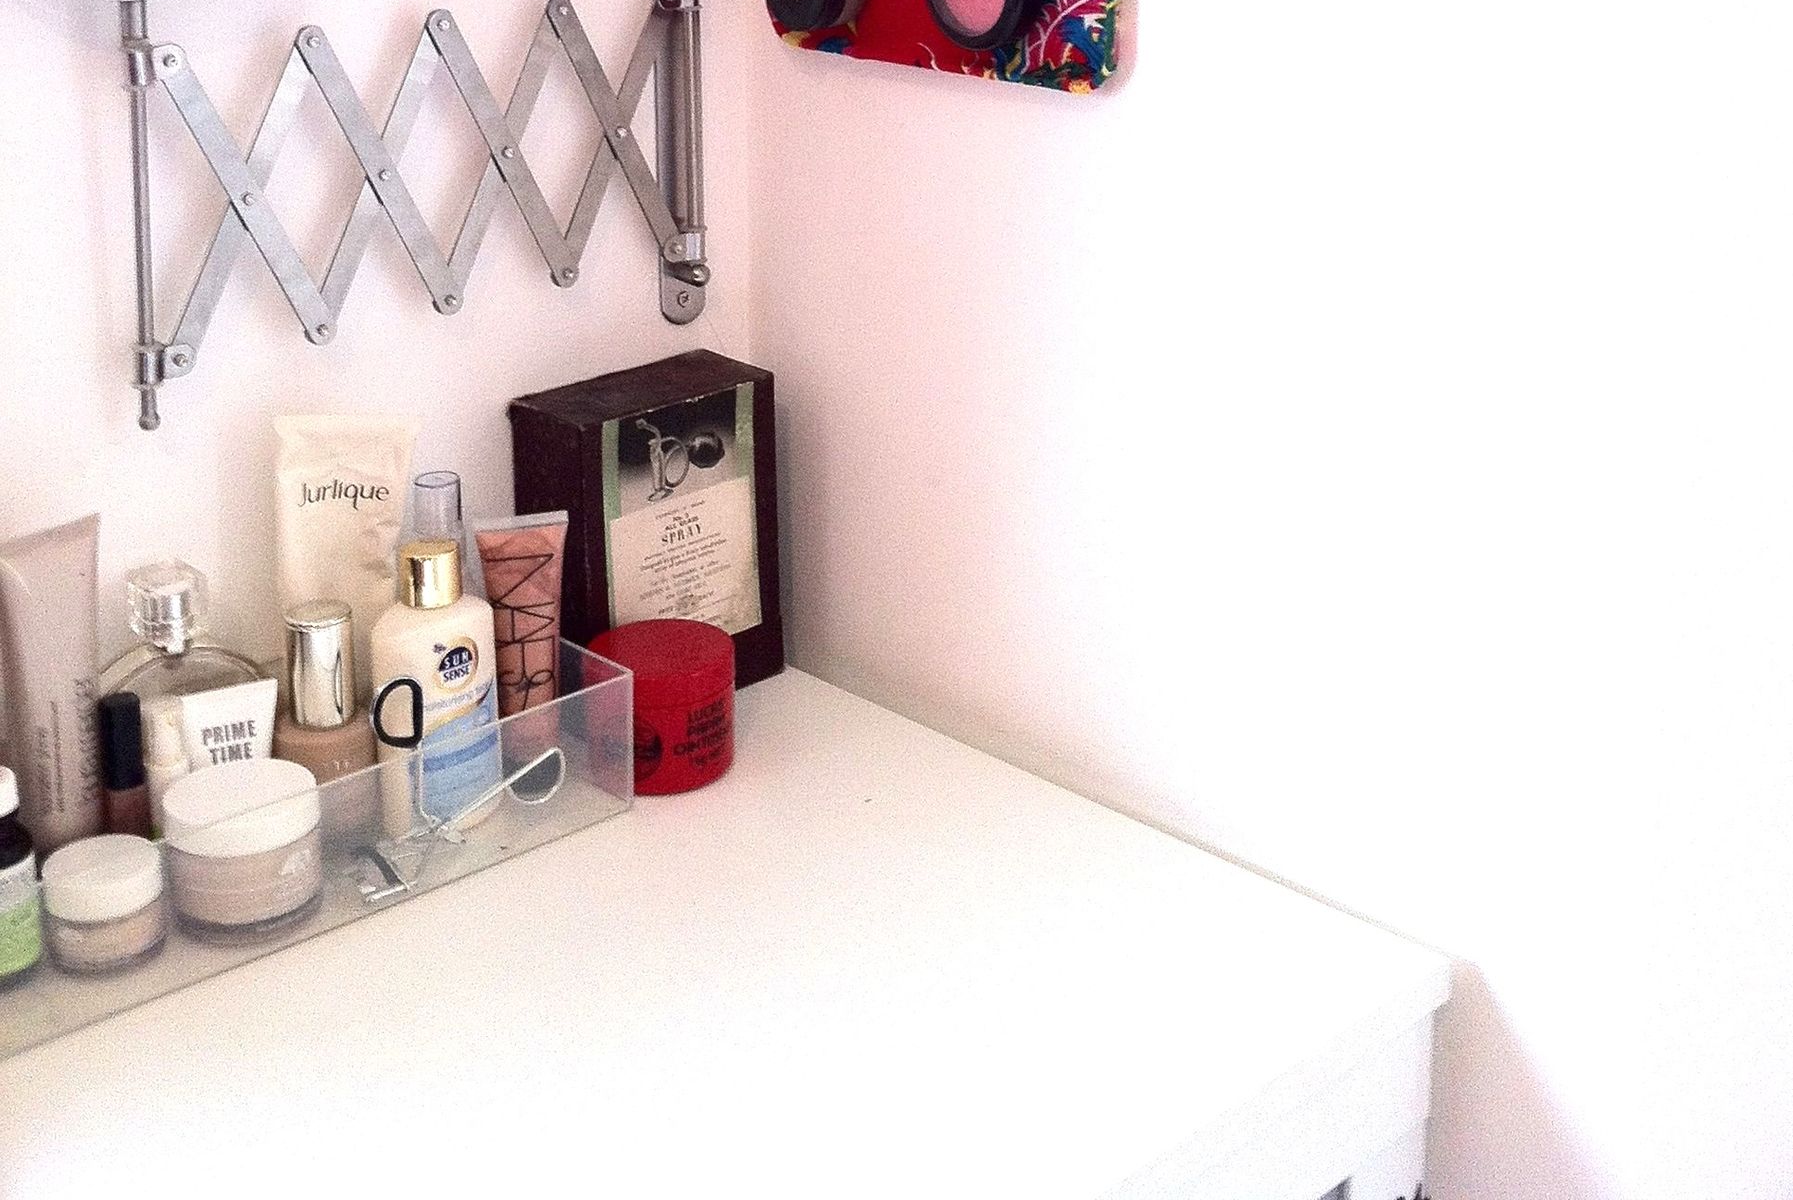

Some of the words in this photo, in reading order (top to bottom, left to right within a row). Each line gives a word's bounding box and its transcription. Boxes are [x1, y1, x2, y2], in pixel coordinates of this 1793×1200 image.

[297, 479, 390, 511] Jurlique
[661, 524, 702, 545] SPRAY
[444, 651, 469, 670] SUN
[443, 665, 470, 682] SENSE
[202, 720, 257, 746] PRIME
[209, 742, 253, 765] TIME
